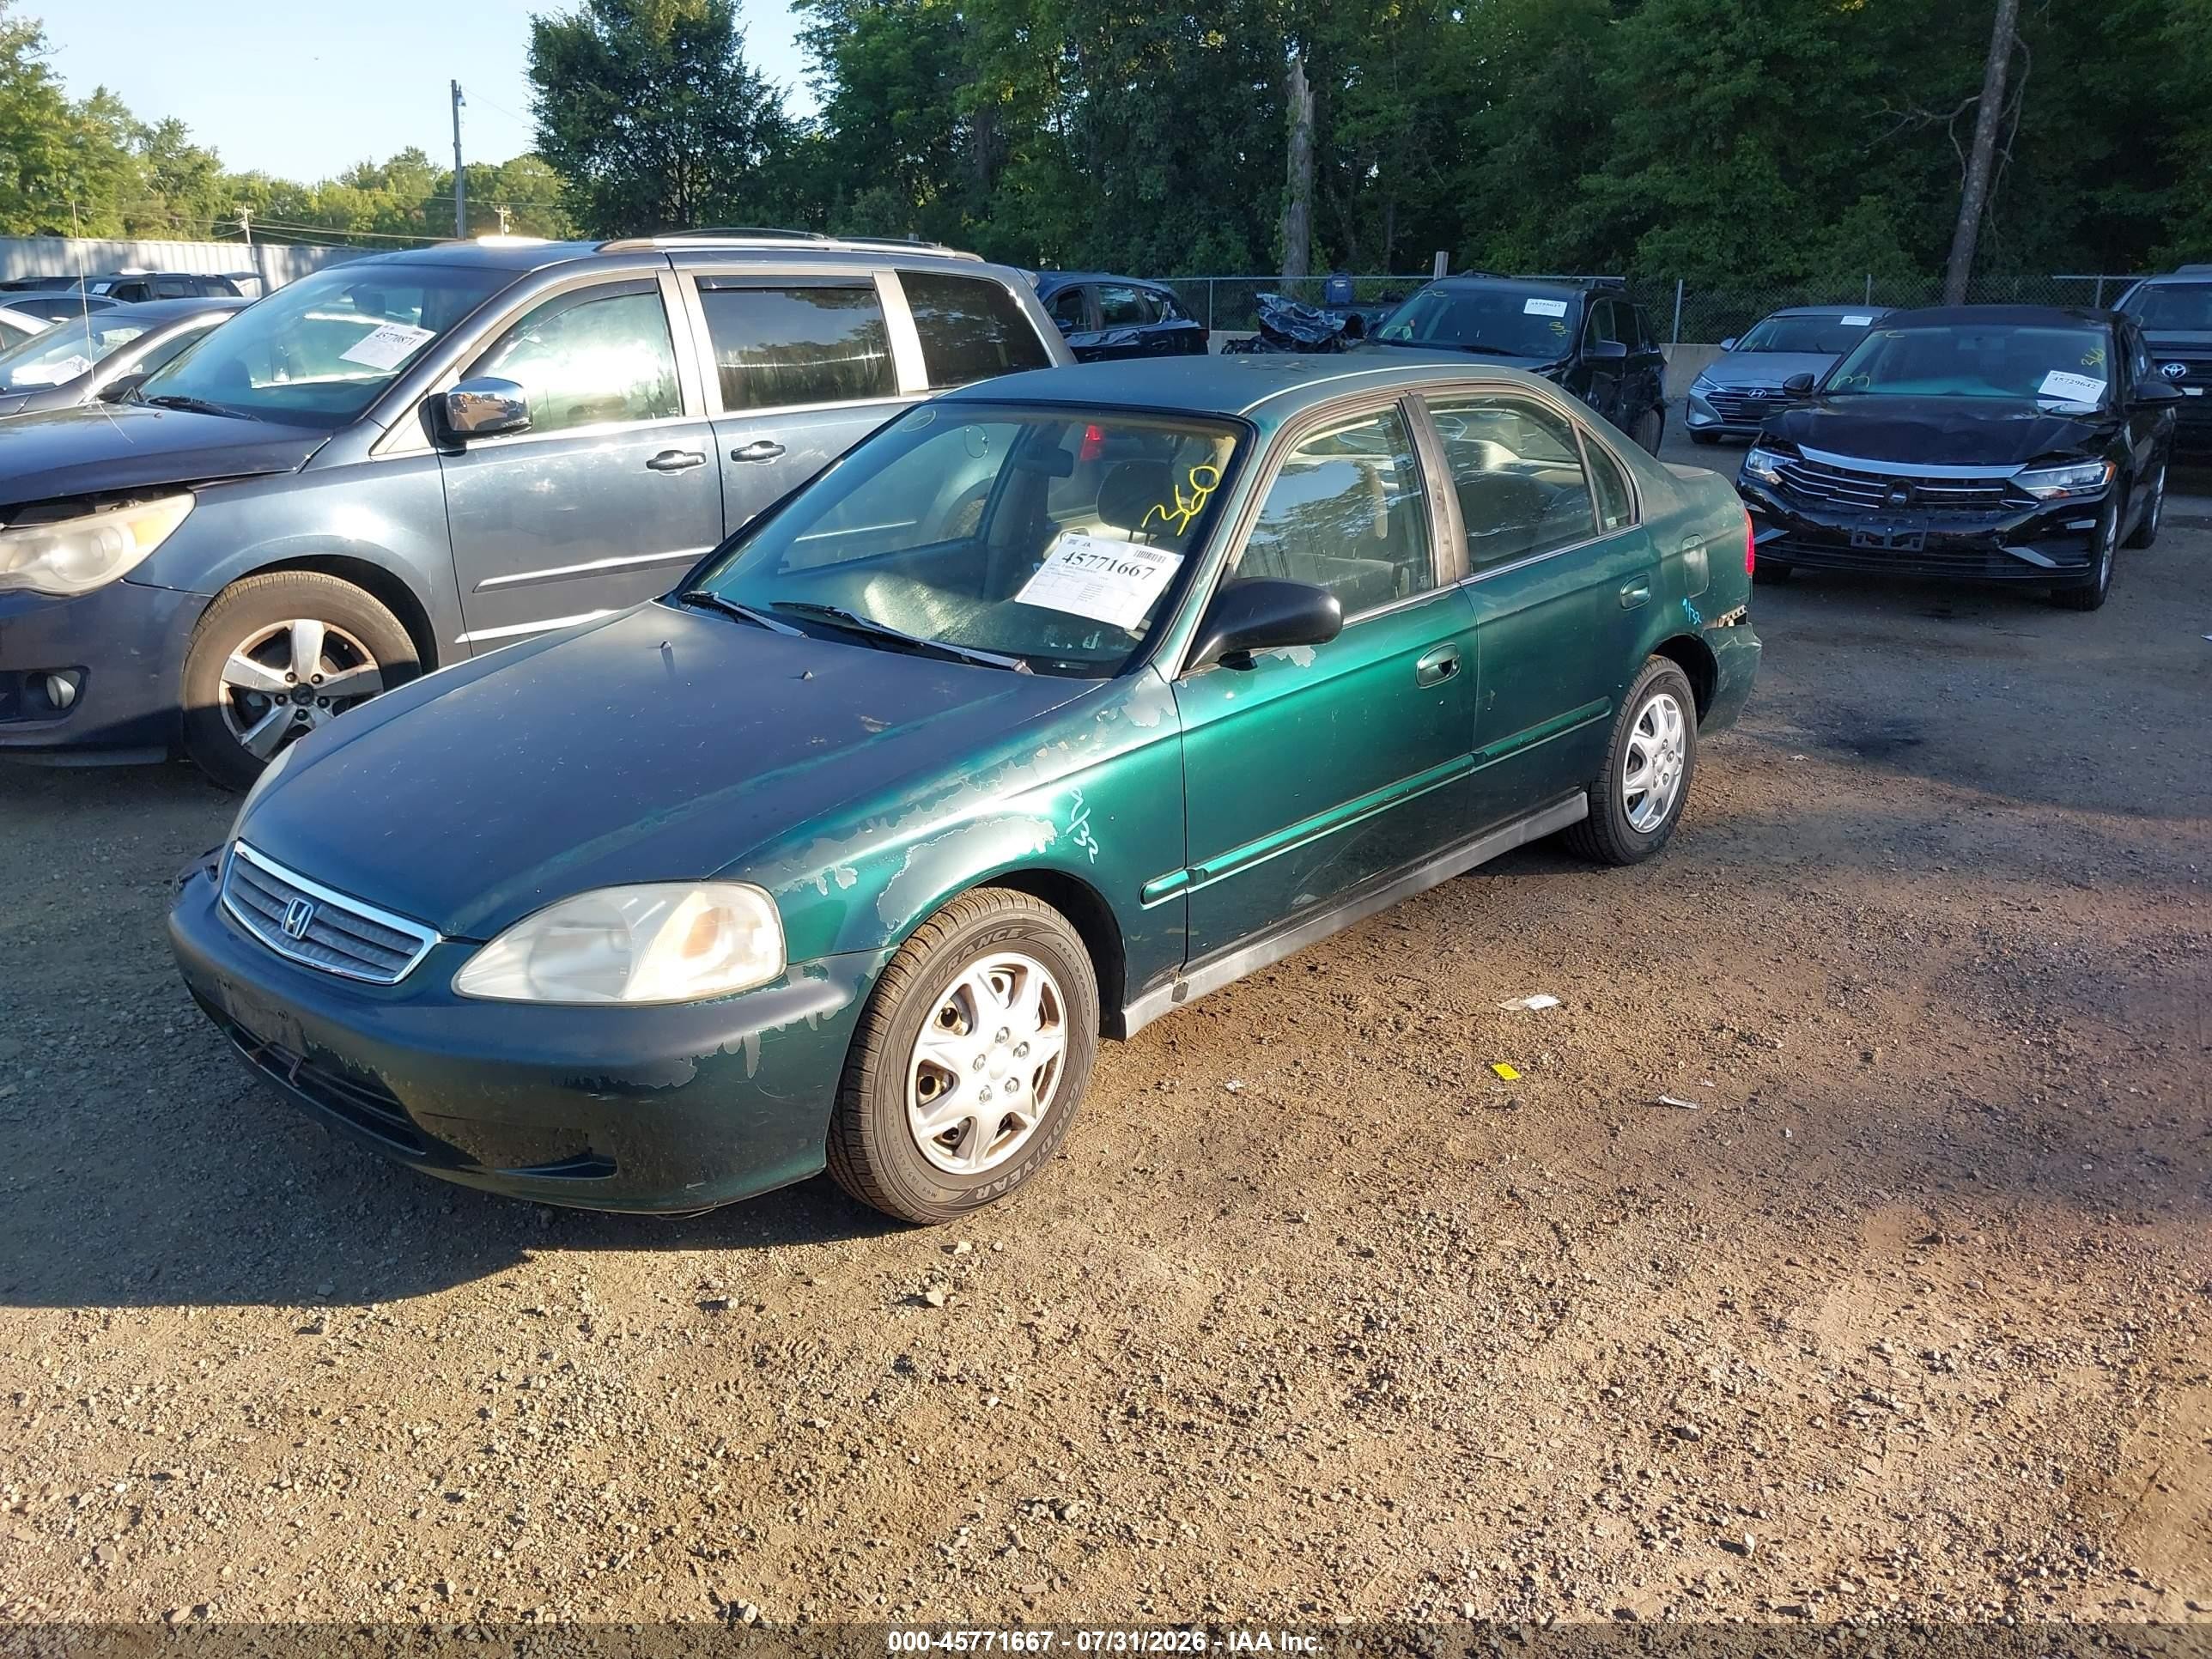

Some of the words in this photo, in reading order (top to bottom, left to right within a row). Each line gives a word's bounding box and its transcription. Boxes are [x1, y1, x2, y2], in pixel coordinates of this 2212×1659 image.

[2052, 377, 2096, 389] 45729642
[1140, 465, 1219, 537] 360
[1061, 551, 1156, 580] 45771667
[975, 1081, 1079, 1200] GOODYEAR
